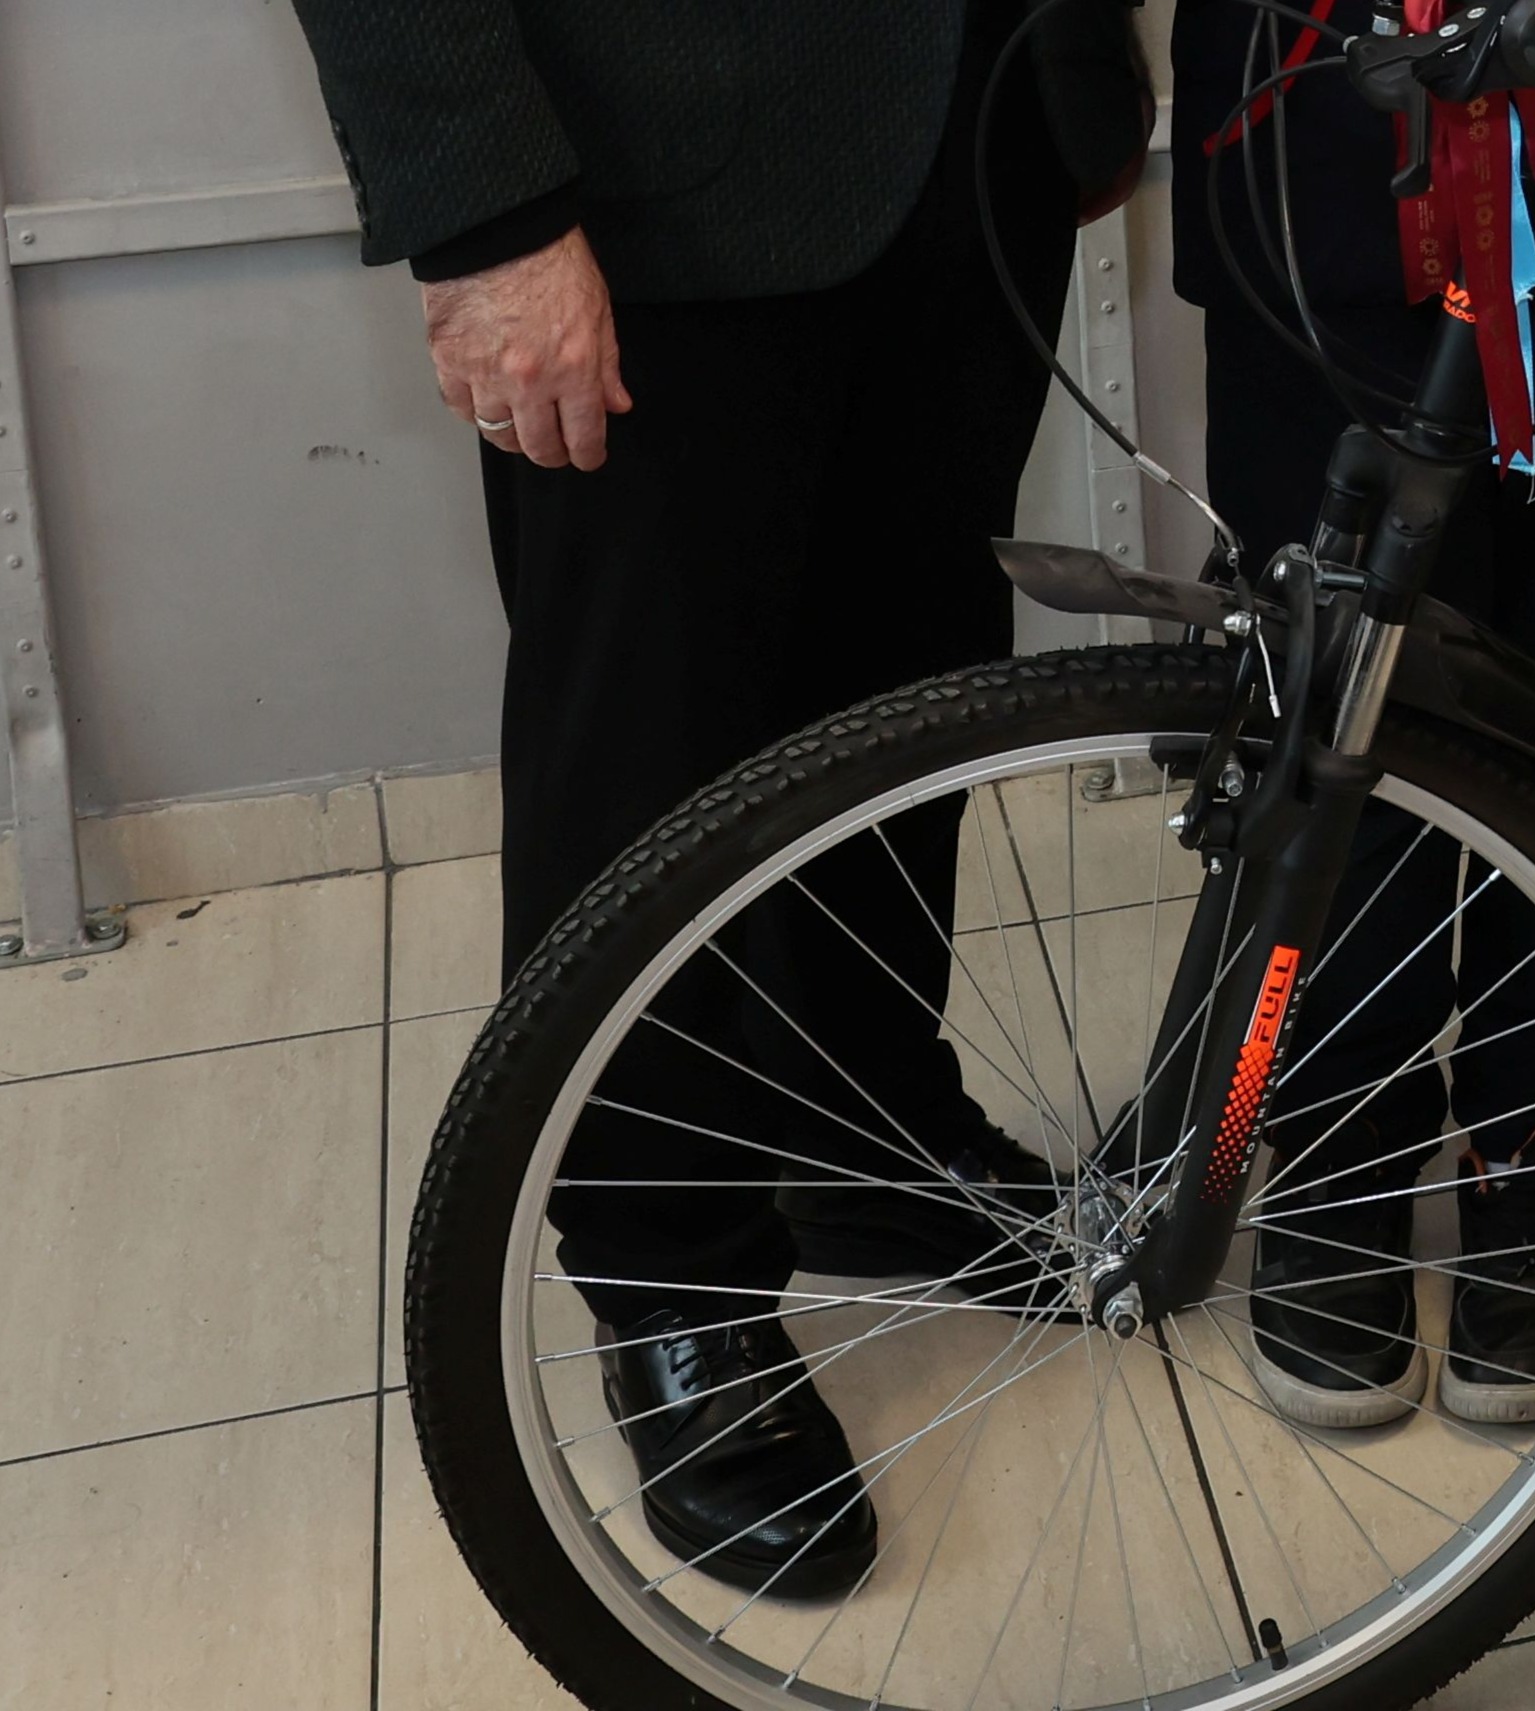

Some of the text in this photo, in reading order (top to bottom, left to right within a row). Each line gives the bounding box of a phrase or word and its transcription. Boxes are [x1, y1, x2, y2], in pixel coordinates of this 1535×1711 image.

[1254, 956, 1293, 1043] FULL
[1240, 976, 1305, 1174] MOUNTAIN BIKE
